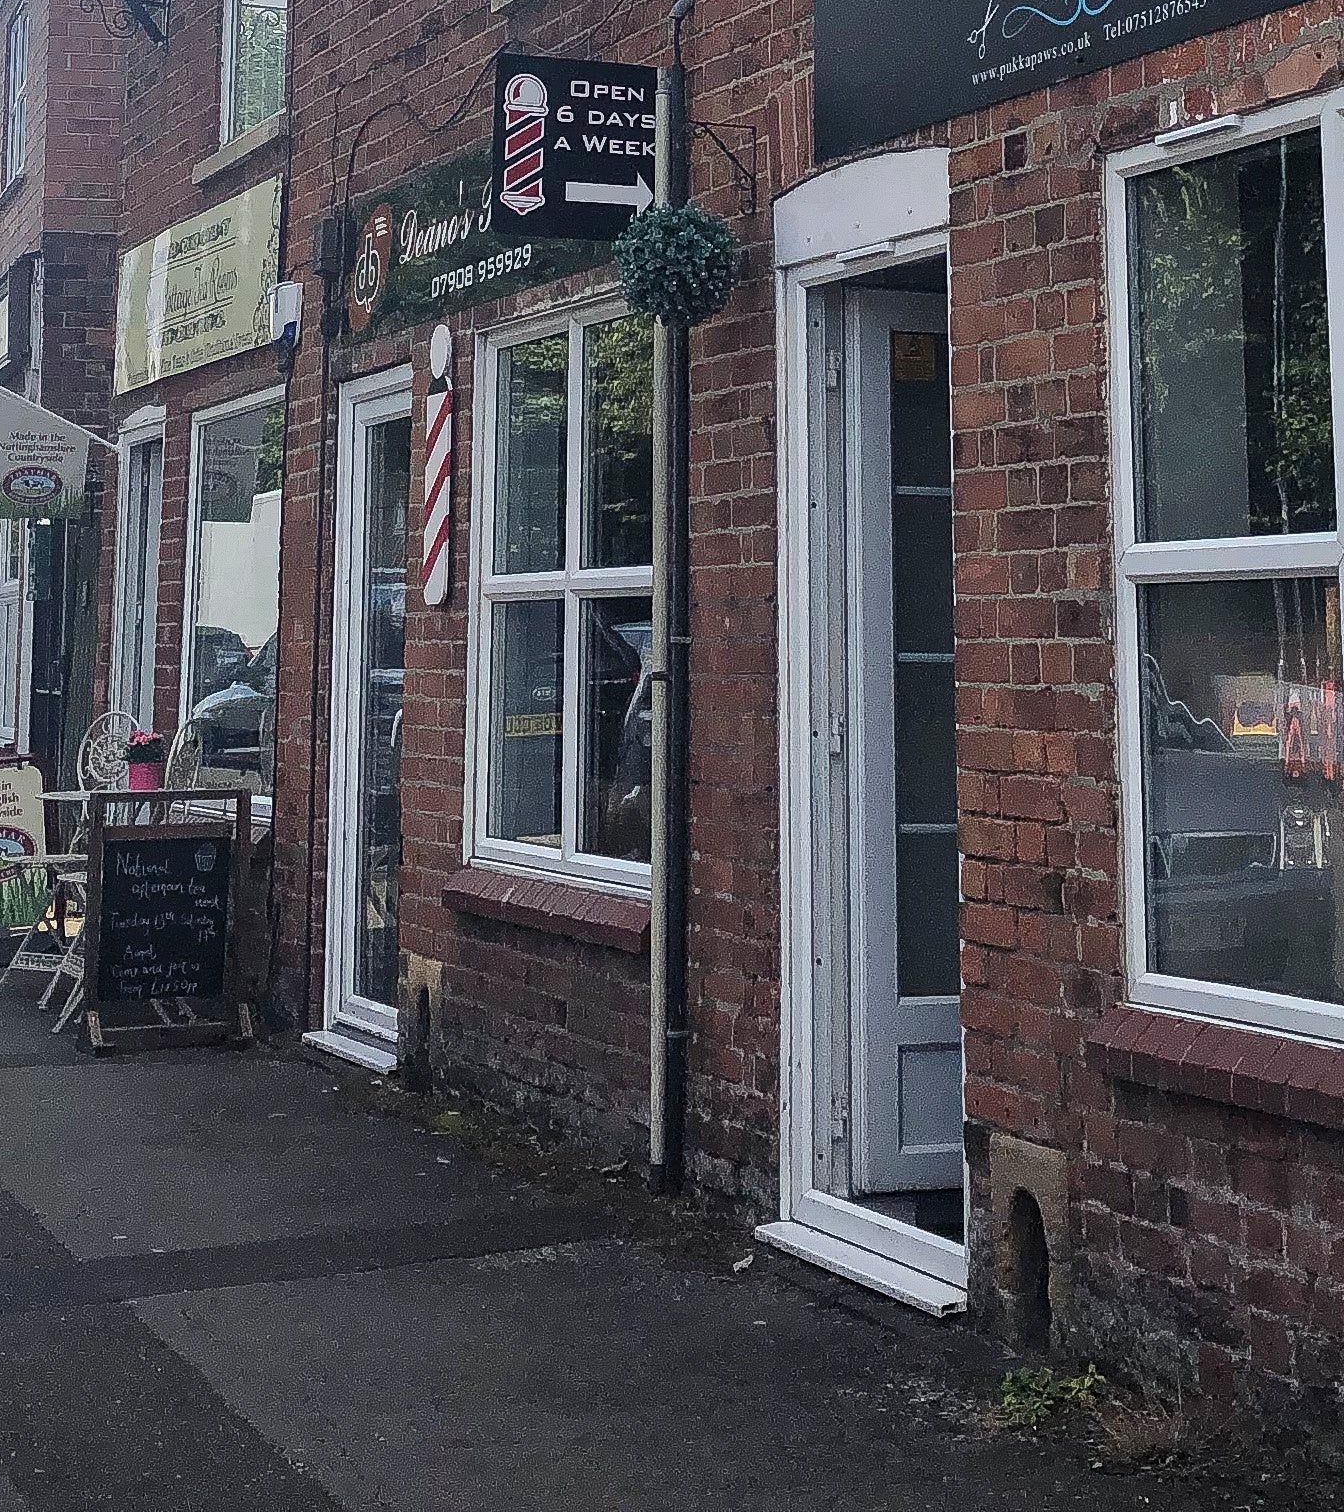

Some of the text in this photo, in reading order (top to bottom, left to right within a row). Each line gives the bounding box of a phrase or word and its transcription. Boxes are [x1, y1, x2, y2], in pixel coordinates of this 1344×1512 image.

[971, 32, 1091, 85] www.pukkapaws.co.uk
[571, 81, 644, 101] OPEN
[557, 106, 655, 129] 6 DAYS
[554, 135, 656, 156] A WEEK
[432, 243, 532, 298] 07908 959929
[8, 431, 66, 441] Made in the
[8, 452, 64, 464] Countryside
[2, 780, 12, 790] in
[117, 852, 168, 877] National
